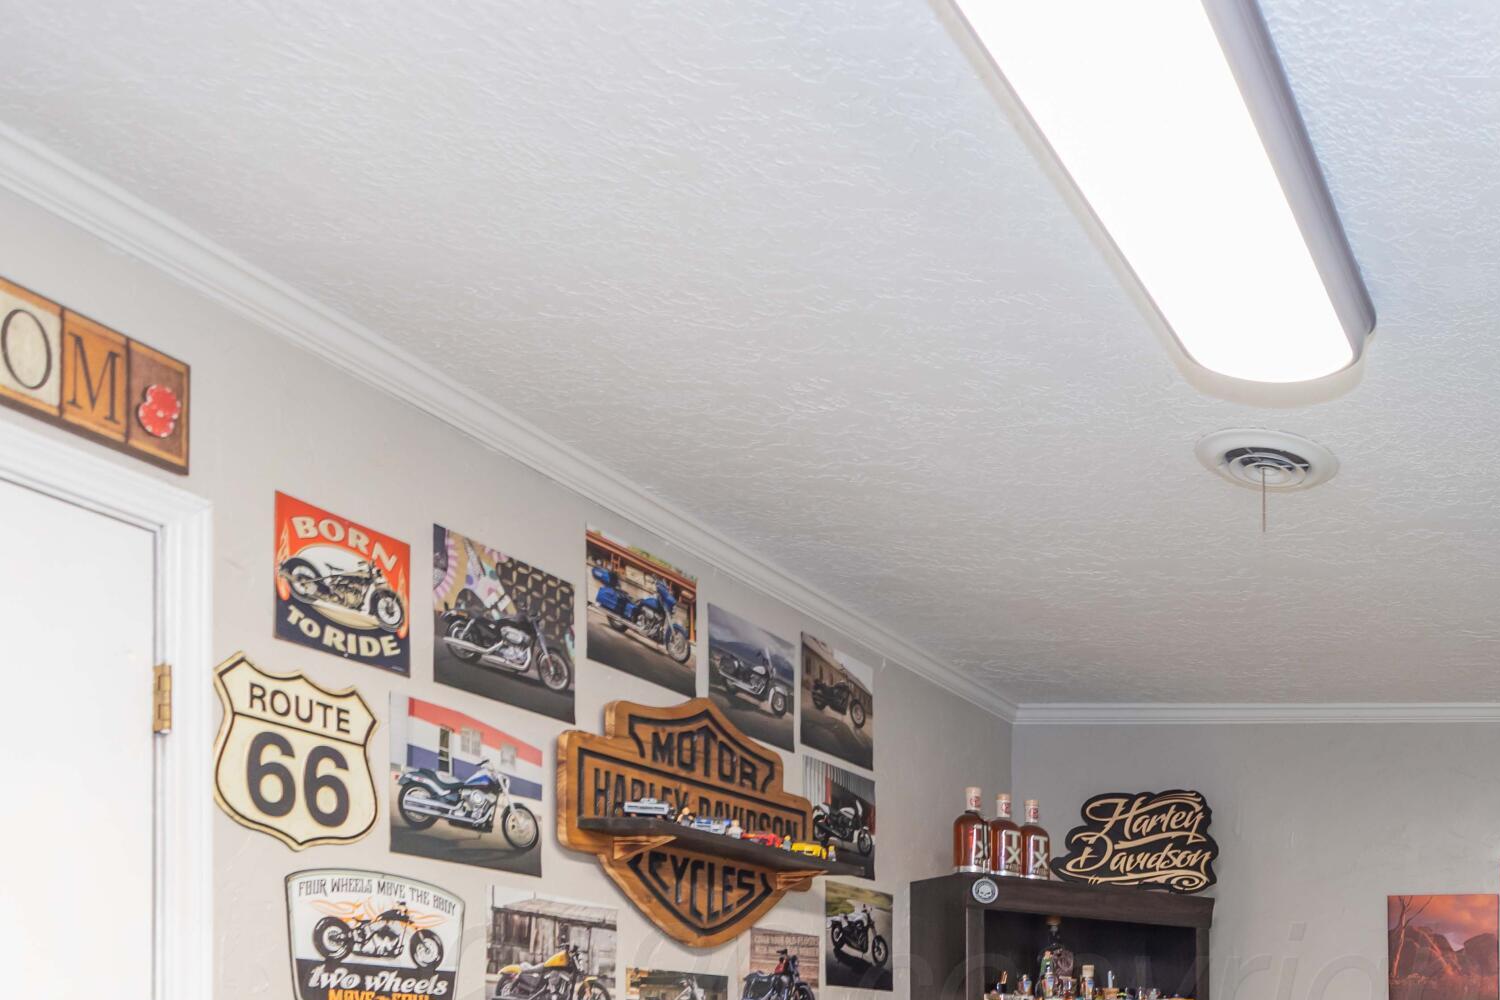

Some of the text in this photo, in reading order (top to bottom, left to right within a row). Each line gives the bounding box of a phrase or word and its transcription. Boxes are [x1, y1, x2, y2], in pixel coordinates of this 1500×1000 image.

[1, 309, 121, 424] OM
[291, 516, 398, 571] BORN
[286, 604, 401, 657] TO RIDE
[249, 682, 351, 735] ROUTE
[247, 731, 350, 828] 66
[652, 725, 759, 793] MOTOR
[1086, 794, 1206, 845] Harley
[1066, 831, 1211, 876] Davidson
[299, 878, 328, 898] FOUR
[331, 878, 373, 894] WHEELS
[377, 881, 406, 899] MOVE
[409, 887, 430, 907] THE
[648, 852, 755, 923] CYCLES
[308, 963, 449, 996] two wheels
